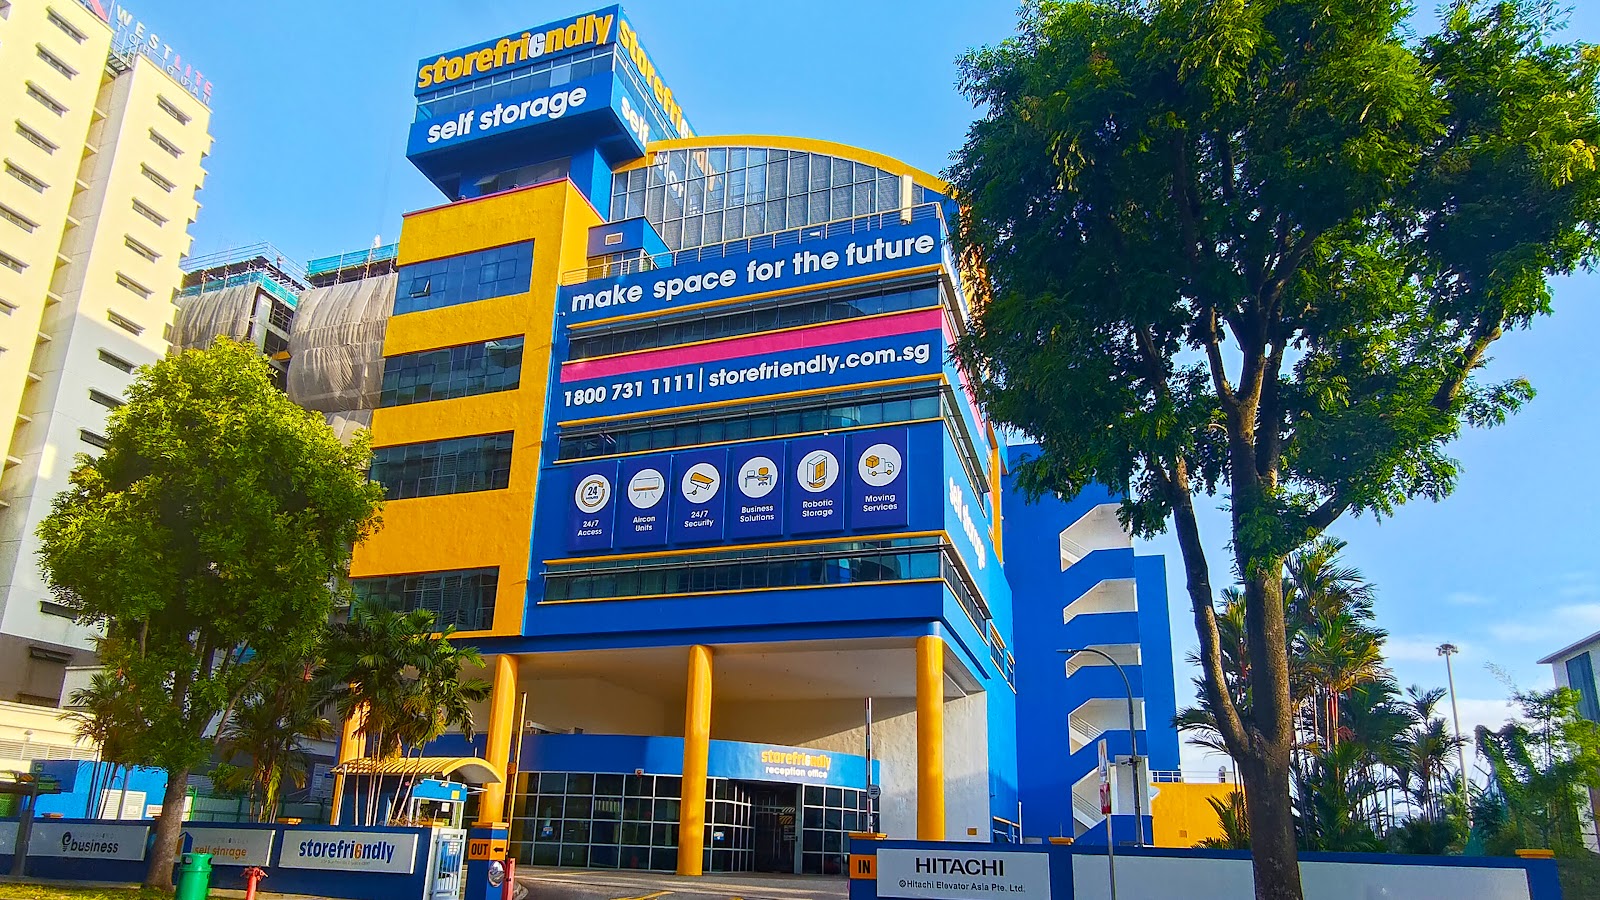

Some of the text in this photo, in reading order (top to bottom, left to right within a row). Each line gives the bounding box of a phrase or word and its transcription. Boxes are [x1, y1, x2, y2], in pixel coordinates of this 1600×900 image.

[116, 4, 213, 97] WESTLITE
[167, 64, 210, 106] GUAN
[427, 86, 588, 143] self storage
[621, 97, 649, 147] self
[571, 234, 935, 312] make space for the future
[564, 343, 930, 407] 1800 731 1111 storefriendly.com.sg
[587, 486, 598, 496] 24
[865, 493, 896, 503] Moving
[741, 504, 774, 514] Business
[802, 499, 834, 509] Robotic
[862, 503, 898, 512] Services
[690, 510, 709, 519] 24/7
[801, 508, 834, 518] Storage
[582, 519, 599, 528] 24/7
[632, 516, 656, 524] Aircon
[684, 519, 714, 528] Security
[739, 514, 775, 523] Solutions
[577, 528, 602, 537] Access
[635, 524, 653, 532] Units
[765, 766, 828, 779] reception office
[299, 838, 396, 864] storefriendly
[471, 843, 488, 856] OUT
[858, 859, 871, 874] IN
[915, 857, 1004, 876] HITACHI
[906, 880, 1026, 893] Hitachi Elevator Asia Pte. Ltd.
